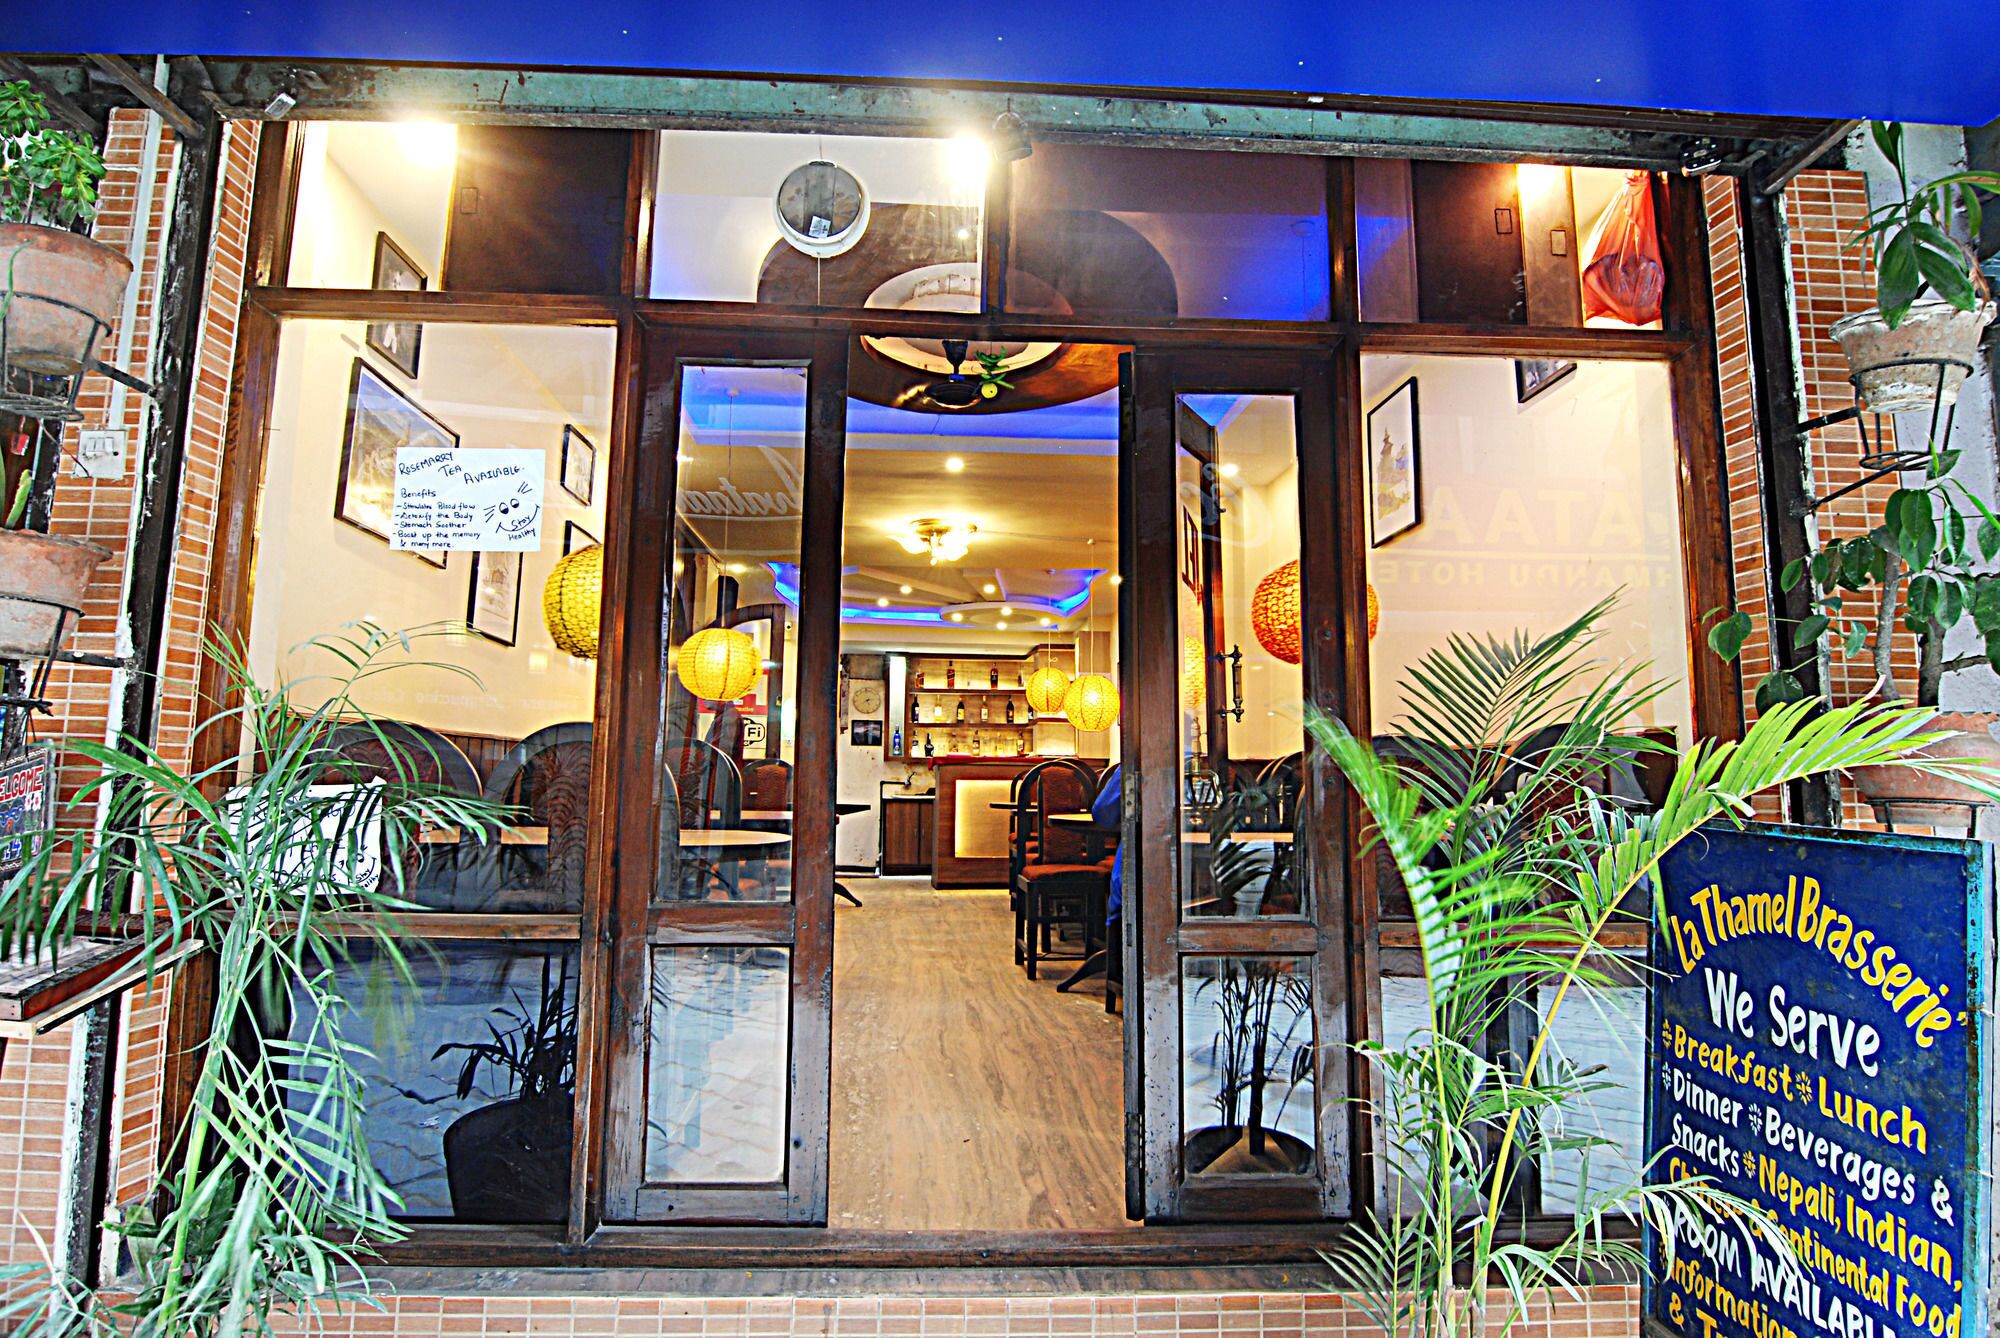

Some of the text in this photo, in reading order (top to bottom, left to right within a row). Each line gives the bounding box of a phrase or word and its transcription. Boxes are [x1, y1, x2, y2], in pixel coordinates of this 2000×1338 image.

[438, 464, 462, 477] TEA
[401, 488, 437, 499] Benefits
[437, 501, 456, 510] Blood
[453, 511, 473, 522] Body
[511, 515, 531, 531] Stay
[411, 541, 430, 549] many
[422, 532, 432, 541] up
[436, 531, 449, 539] the
[452, 532, 480, 540] memory
[508, 528, 536, 541] Healthy
[0, 764, 44, 803] ELCOME
[1690, 874, 1796, 947] Thamel
[1704, 967, 1880, 1078] We Serve
[1674, 1024, 1927, 1155] Breakfast Lunch
[1673, 1067, 1955, 1227] Dinner Beverages &
[1672, 1112, 1963, 1292] Snacks Nepali, Indian,
[1668, 1291, 1685, 1332] &
[1896, 1274, 1963, 1338] Food
